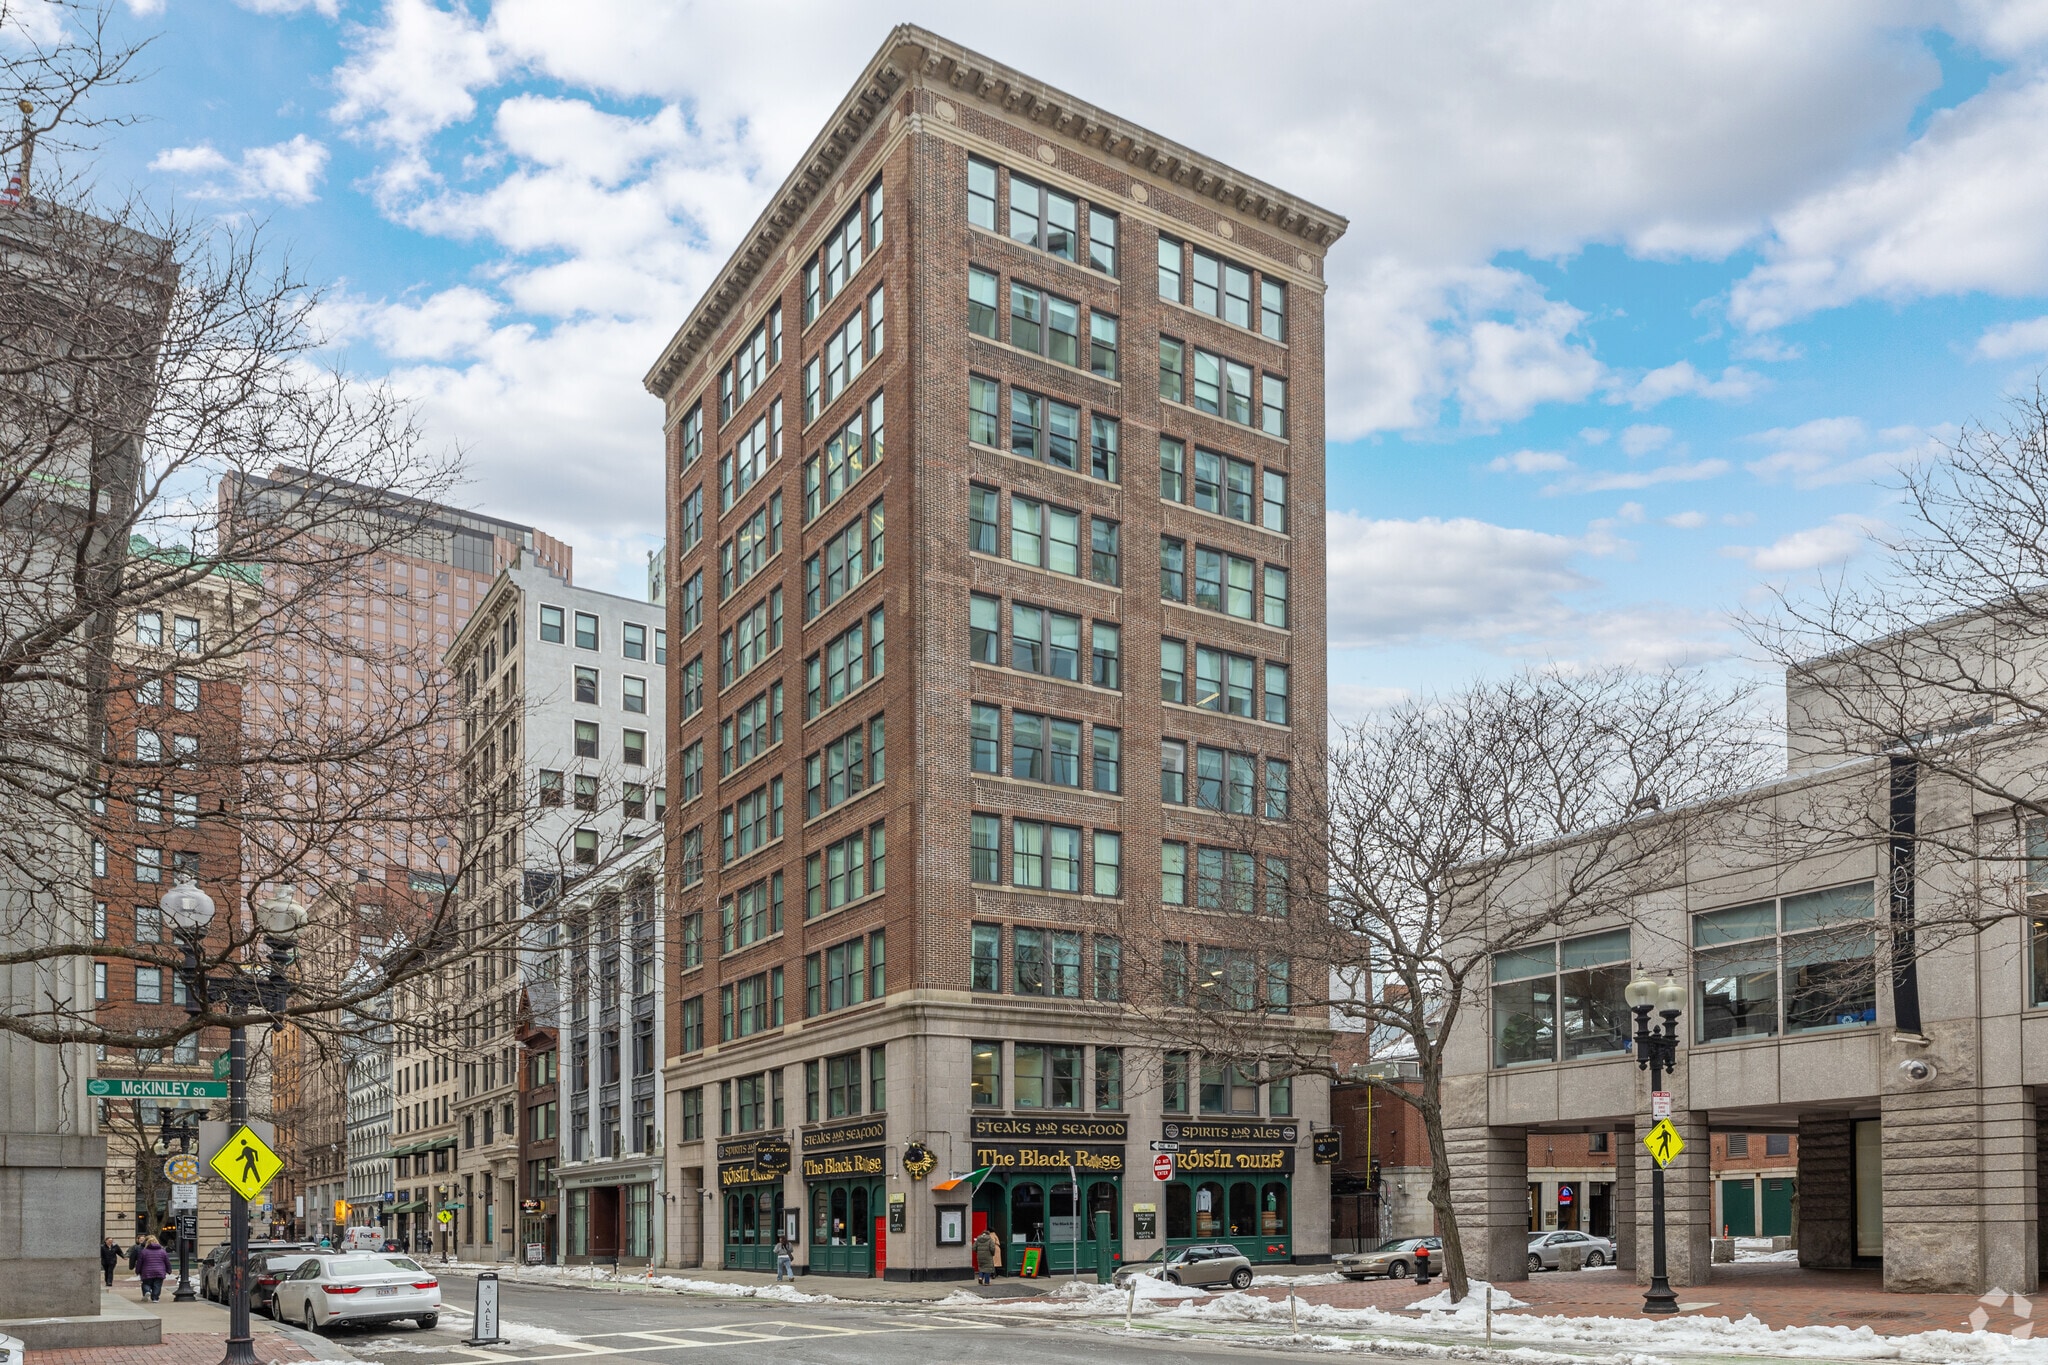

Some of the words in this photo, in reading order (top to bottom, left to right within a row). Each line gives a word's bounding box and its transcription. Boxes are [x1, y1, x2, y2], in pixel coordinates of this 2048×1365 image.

[121, 1081, 190, 1095] McKINLEY
[193, 1088, 206, 1096] SQ
[804, 1132, 831, 1146] STEAKS
[846, 1124, 884, 1140] SEAFOOD
[976, 1120, 1031, 1134] STEAKS
[1036, 1122, 1058, 1135] AND
[1062, 1123, 1125, 1137] SEAFOOD
[1182, 1126, 1229, 1138] SPIRITS
[1231, 1128, 1250, 1138] AND
[1253, 1127, 1280, 1138] ALES
[977, 1149, 1015, 1166] The
[1018, 1149, 1072, 1166] Black
[804, 1160, 823, 1176] The
[824, 1156, 853, 1174] Black
[895, 1214, 899, 1222] 7
[1142, 1222, 1148, 1230] 7
